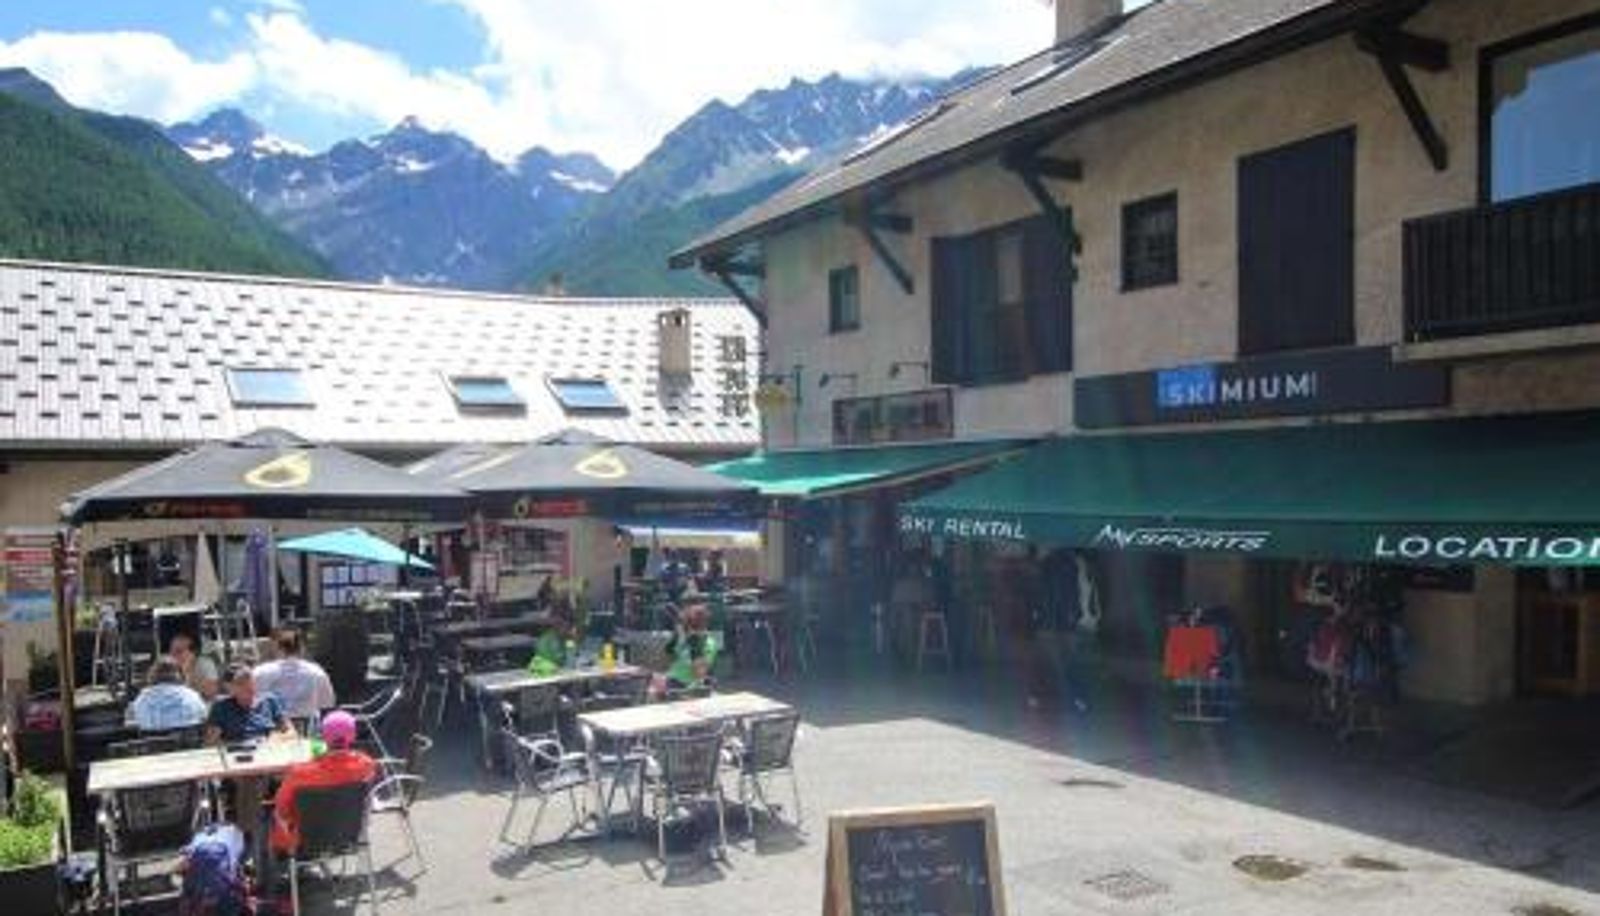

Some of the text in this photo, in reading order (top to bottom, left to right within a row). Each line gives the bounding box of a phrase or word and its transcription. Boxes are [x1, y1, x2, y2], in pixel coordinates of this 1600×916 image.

[1166, 372, 1311, 406] SKIMIUM
[900, 514, 1027, 539] SKI RENTAL
